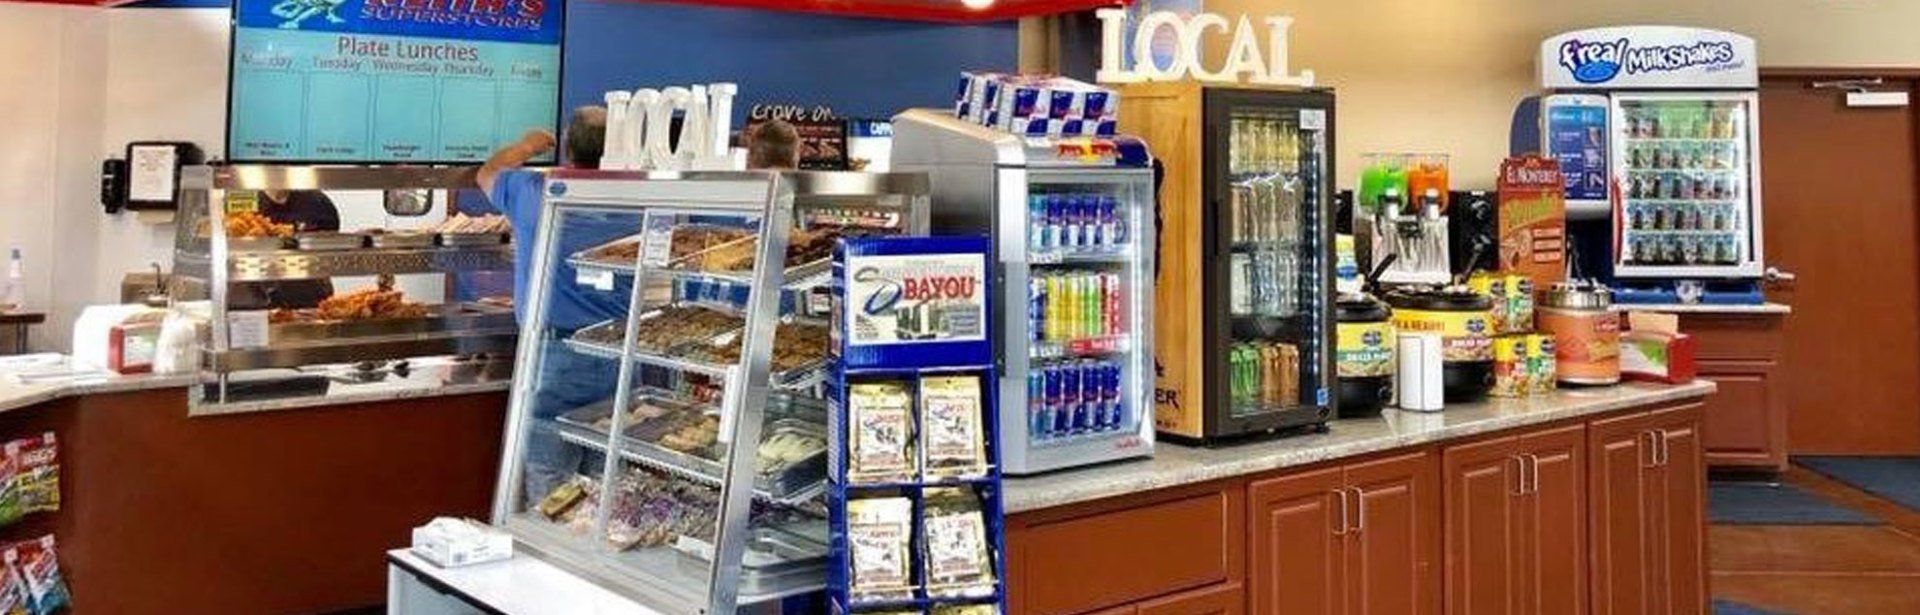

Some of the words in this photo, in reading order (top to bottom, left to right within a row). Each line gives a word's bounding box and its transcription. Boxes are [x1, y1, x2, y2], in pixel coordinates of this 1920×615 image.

[337, 36, 389, 57] Plate
[397, 39, 479, 61] Lunches
[1096, 8, 1315, 87] LOCAL
[903, 276, 976, 301] BAYOU
